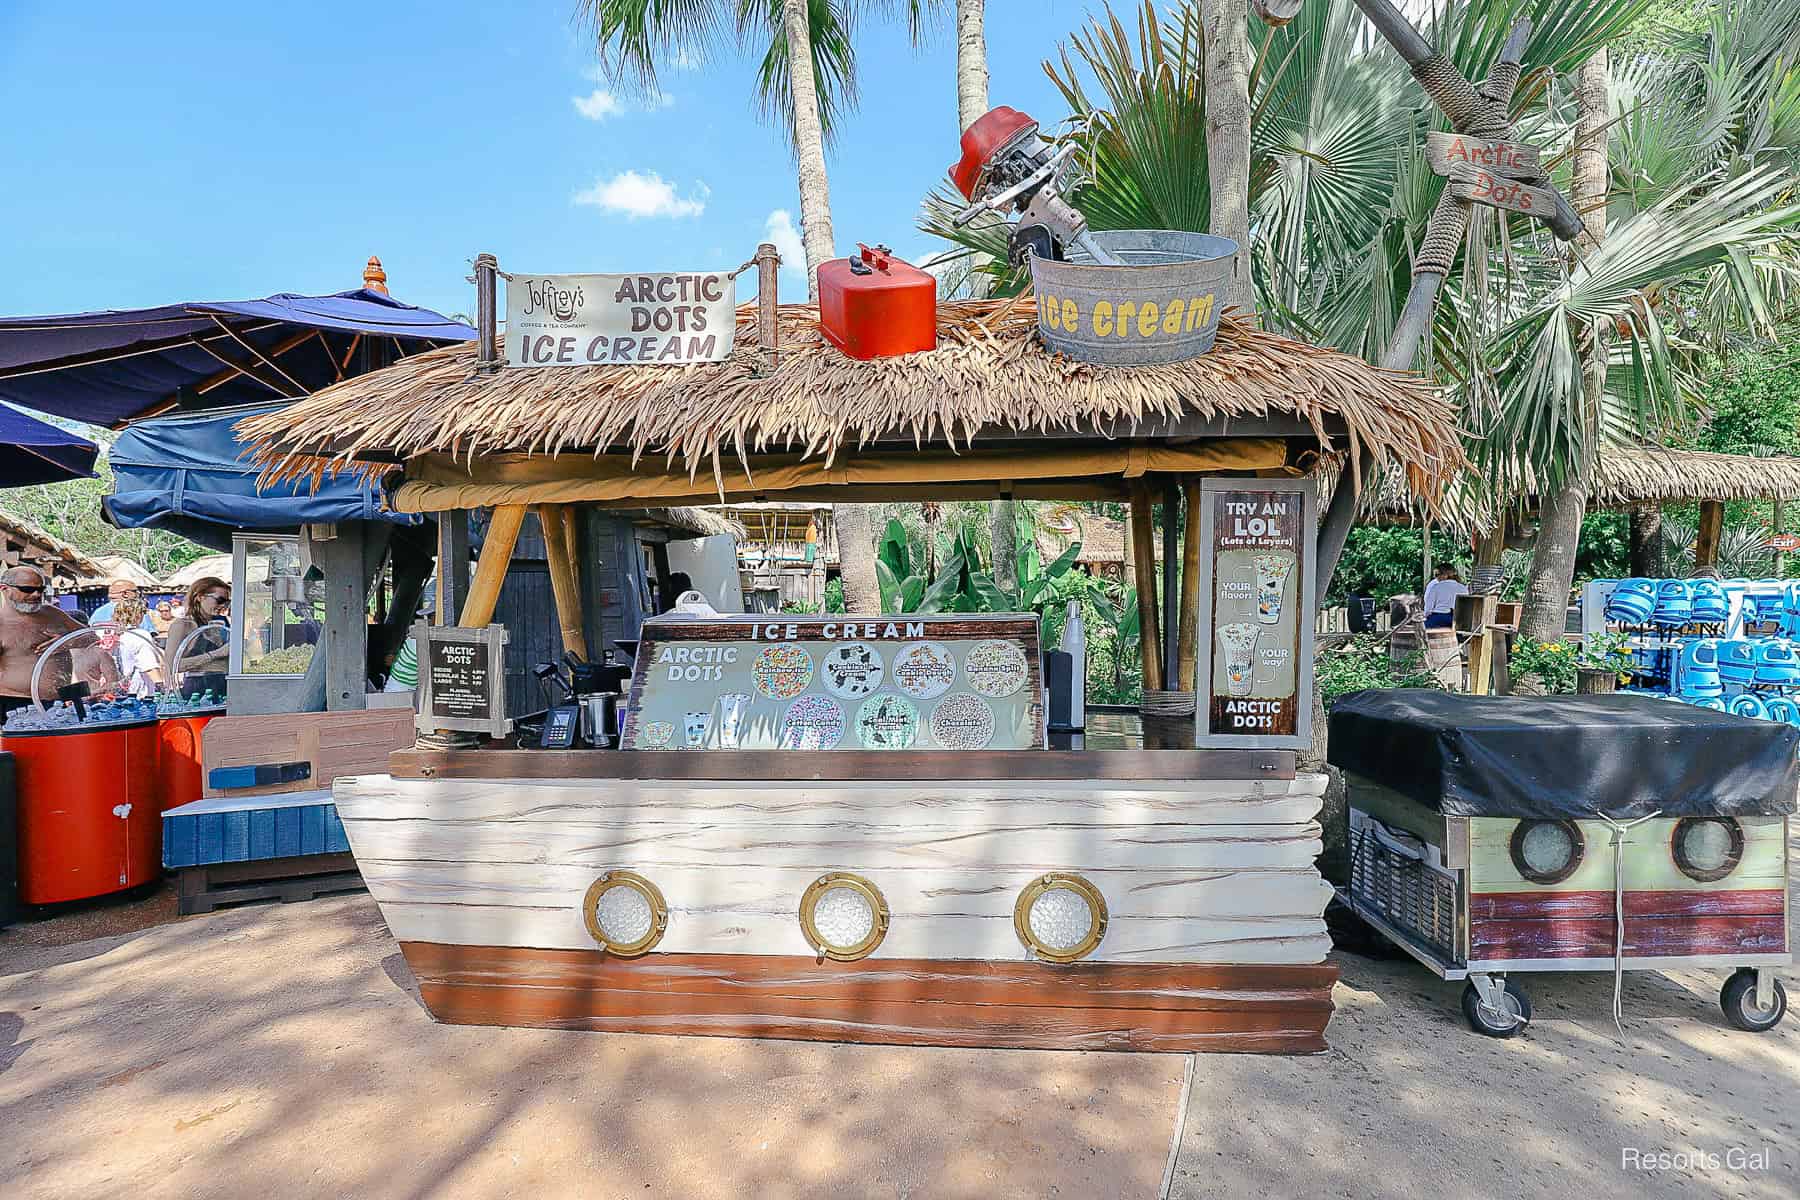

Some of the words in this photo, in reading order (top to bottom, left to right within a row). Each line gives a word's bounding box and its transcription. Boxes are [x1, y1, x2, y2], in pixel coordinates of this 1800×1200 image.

[1447, 138, 1525, 169] Arctic
[1472, 172, 1533, 209] Dots
[615, 275, 723, 303] ARCTIC
[523, 279, 584, 318] Joffrey's
[630, 305, 708, 333] DOTS
[1093, 293, 1215, 337] cream
[521, 335, 577, 363] ICE
[586, 334, 716, 362] CREAM
[1226, 502, 1257, 515] TRY
[1262, 502, 1287, 515] AN
[1234, 518, 1281, 537] LOL
[1221, 537, 1244, 546] (Lots
[1246, 536, 1256, 545] of
[1259, 537, 1293, 547] Layers)
[1222, 582, 1251, 591] YOUR
[751, 623, 798, 640] ICE
[822, 622, 925, 639] CREAM
[441, 646, 477, 656] ARCTIC
[447, 655, 472, 664] DOTS
[658, 647, 738, 664] ARCTIC
[1260, 648, 1288, 658] YOUR
[667, 665, 723, 681] DOTS
[1225, 700, 1281, 714] ARCTIC
[1233, 715, 1273, 728] DOTS
